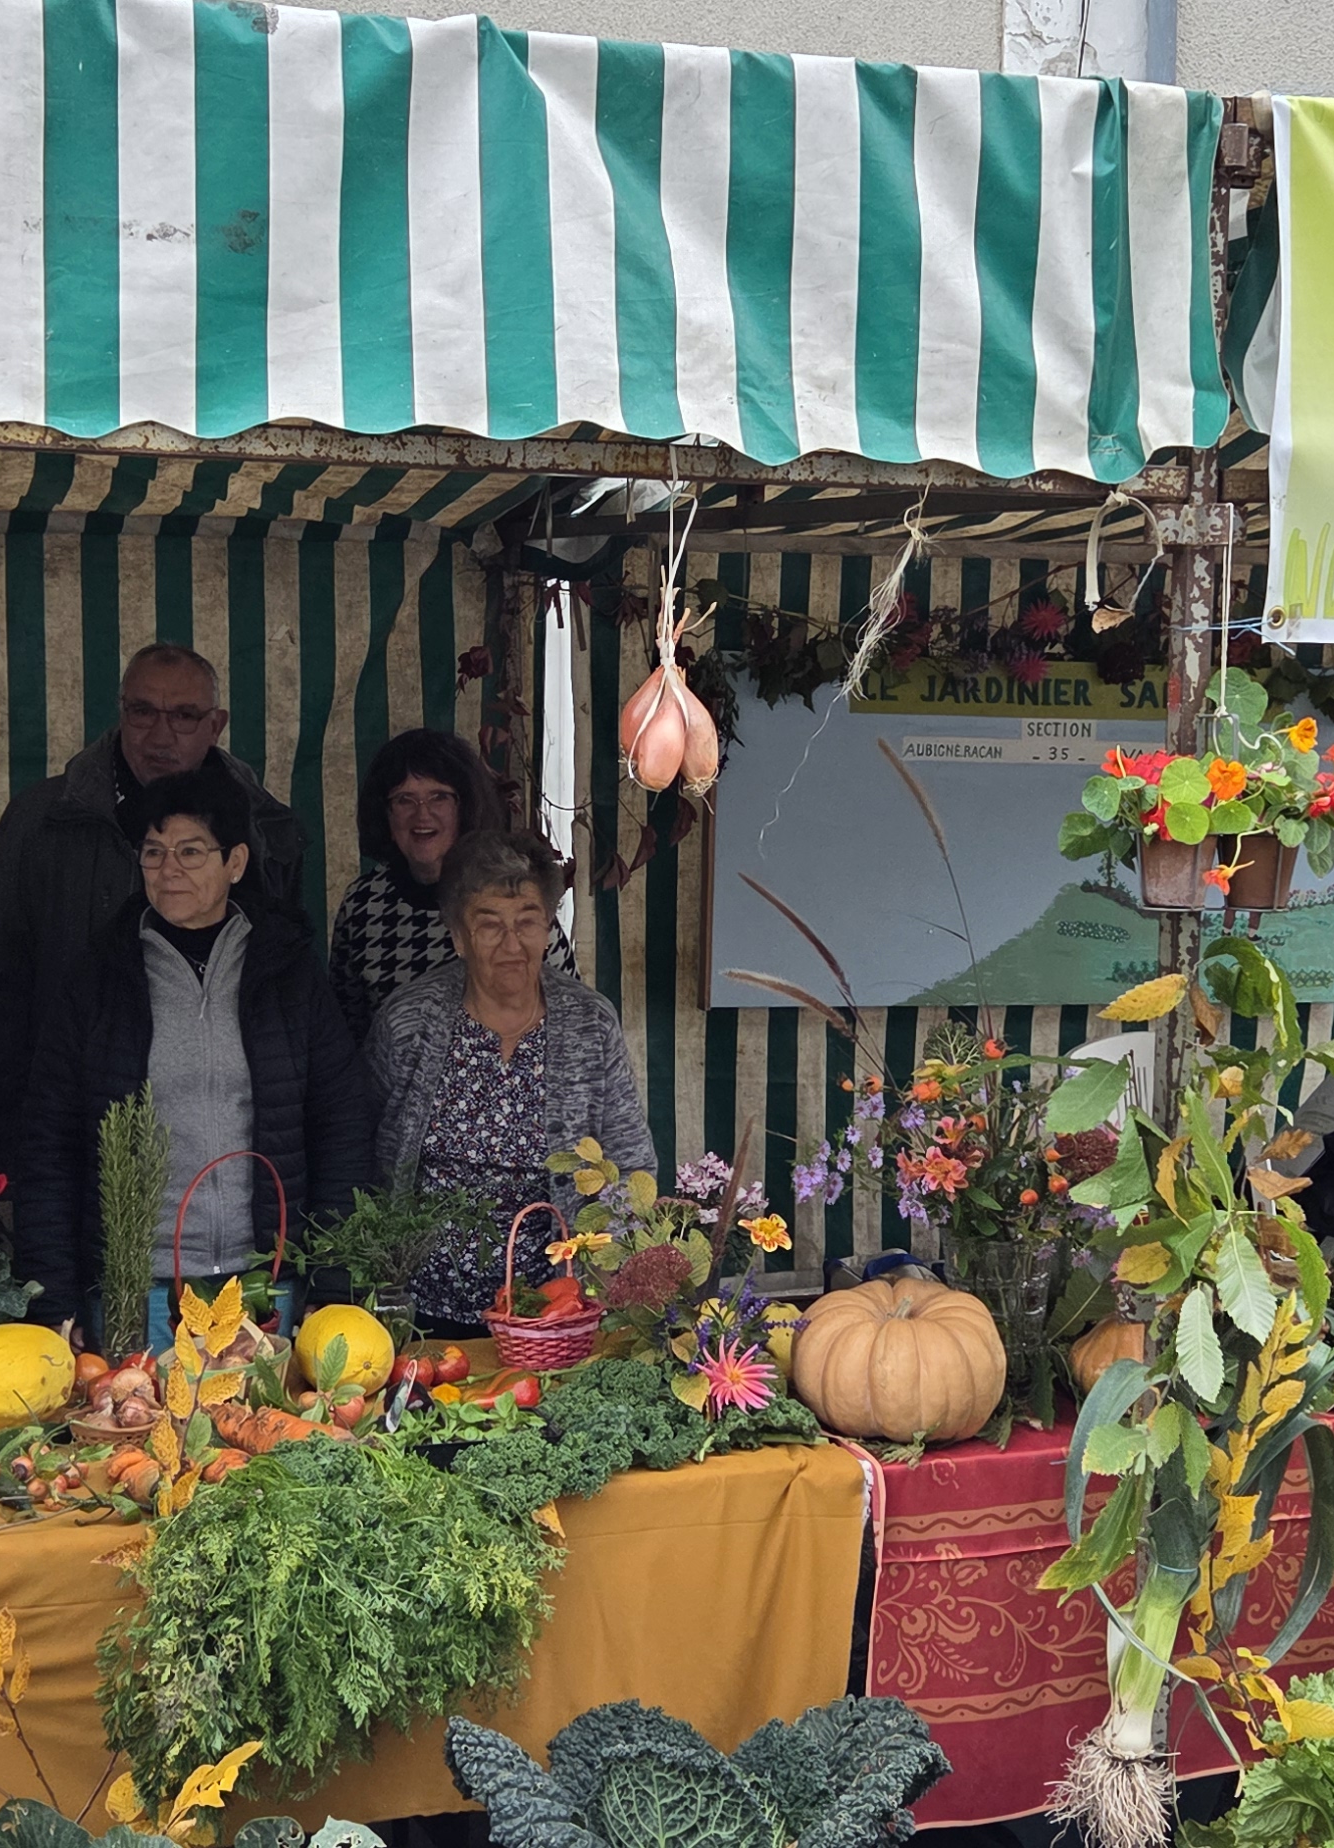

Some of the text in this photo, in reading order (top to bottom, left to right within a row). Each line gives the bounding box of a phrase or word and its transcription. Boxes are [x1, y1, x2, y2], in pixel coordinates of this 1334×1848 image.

[920, 672, 1094, 706] JARDINIER
[1119, 681, 1167, 709] SA
[1027, 721, 1092, 738] SECTION
[1049, 746, 1070, 760] 35
